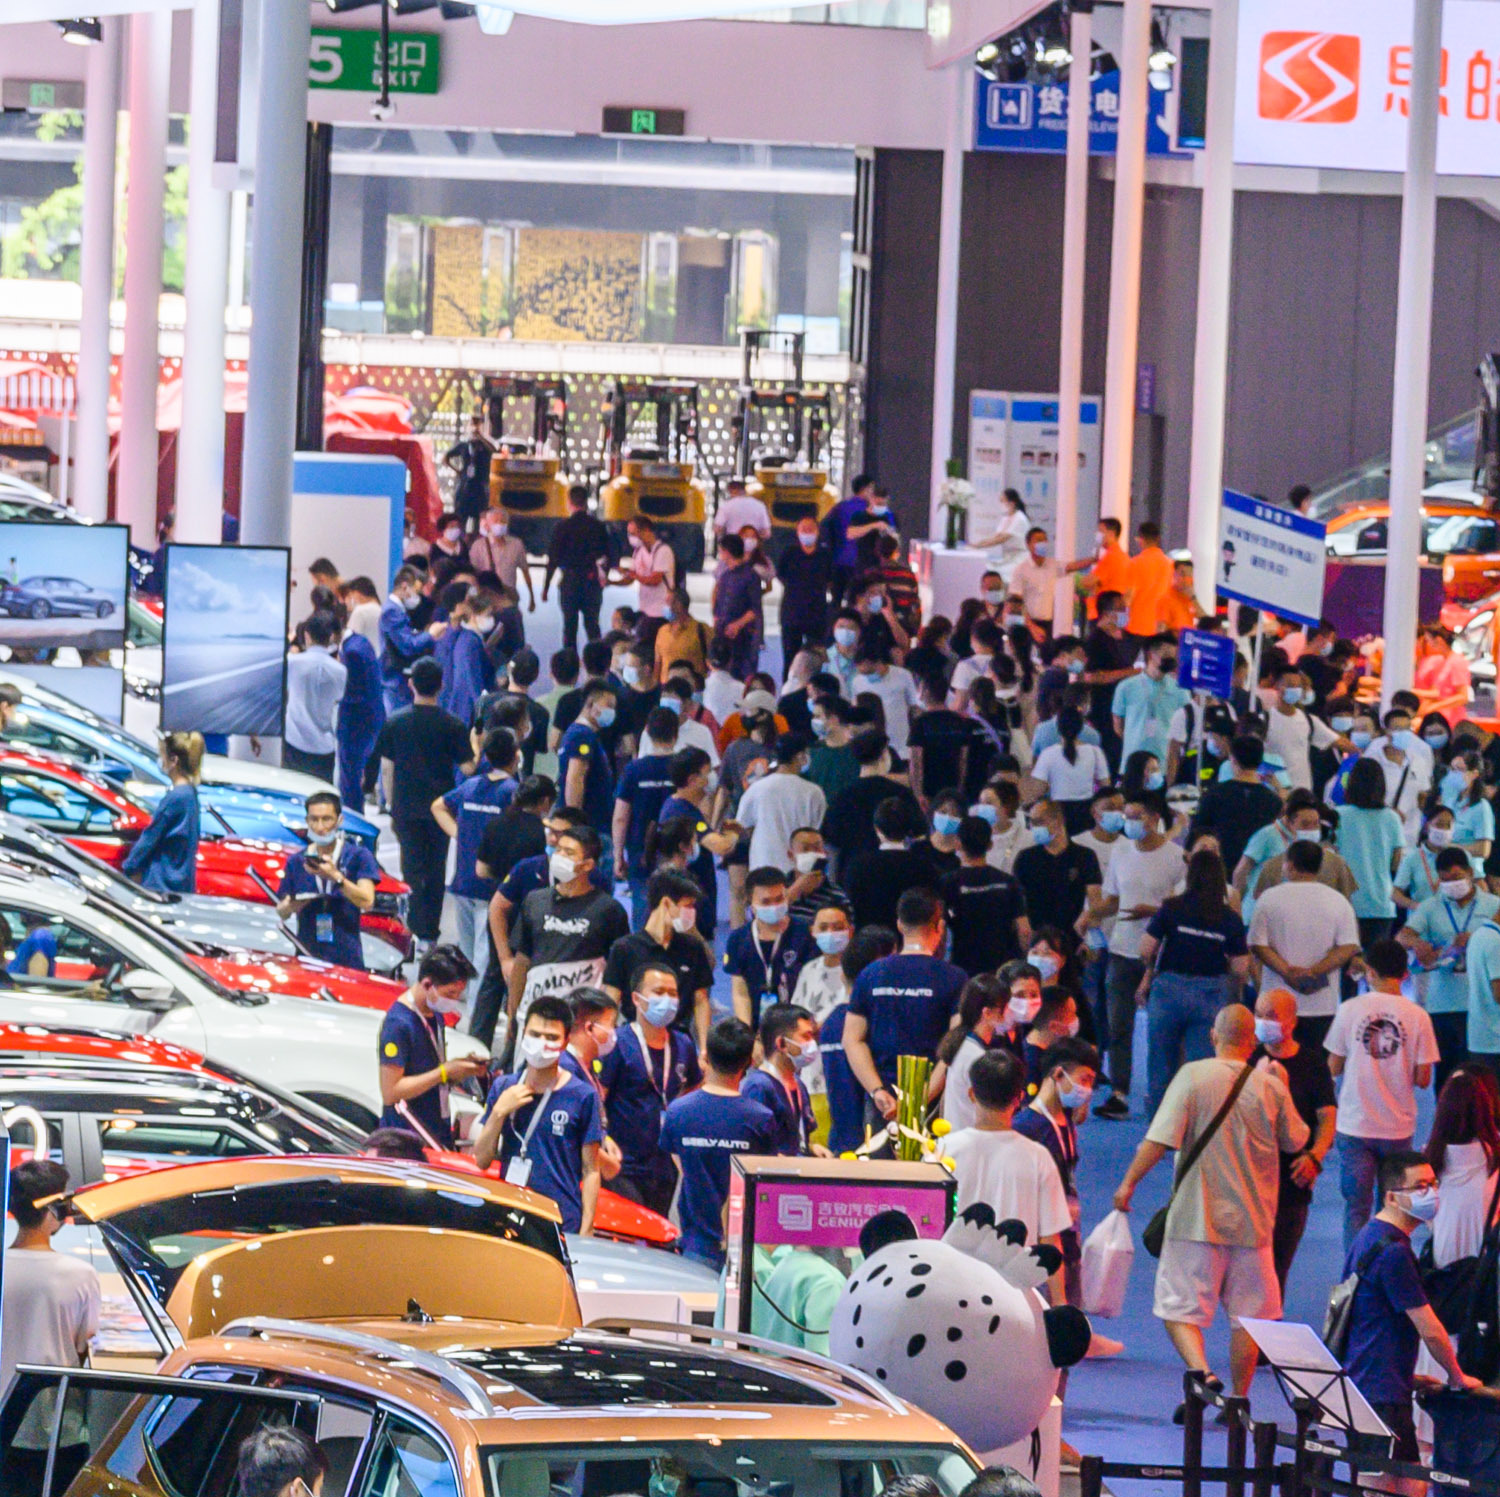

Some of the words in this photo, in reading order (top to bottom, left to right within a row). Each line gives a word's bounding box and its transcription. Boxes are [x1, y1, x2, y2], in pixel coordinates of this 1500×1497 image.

[309, 34, 343, 82] 5
[373, 40, 426, 66] 出口
[371, 70, 421, 87] EXIT
